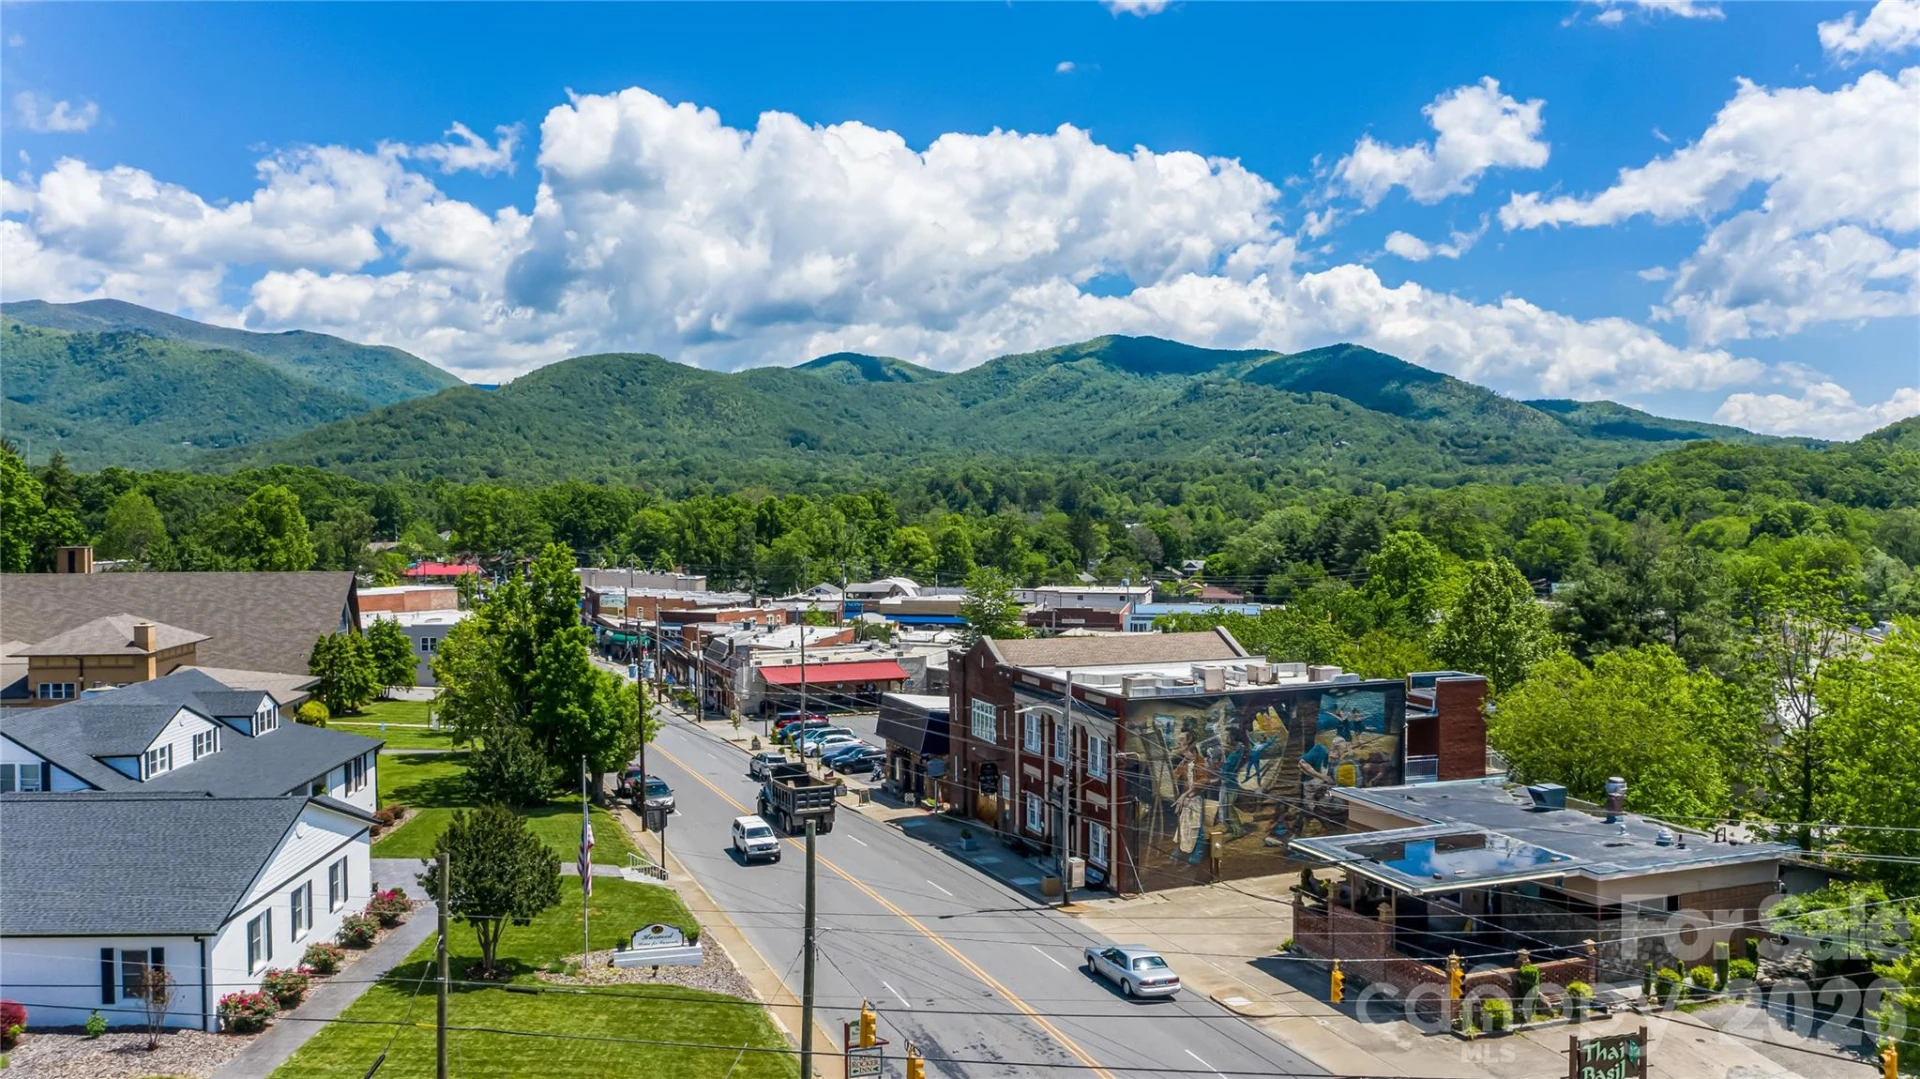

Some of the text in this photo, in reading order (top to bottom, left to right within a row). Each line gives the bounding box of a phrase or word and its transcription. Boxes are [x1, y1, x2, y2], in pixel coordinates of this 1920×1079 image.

[1582, 1041, 1625, 1062] Thai
[851, 1060, 879, 1069] ROCKER
[1582, 1059, 1626, 1079] Basil
